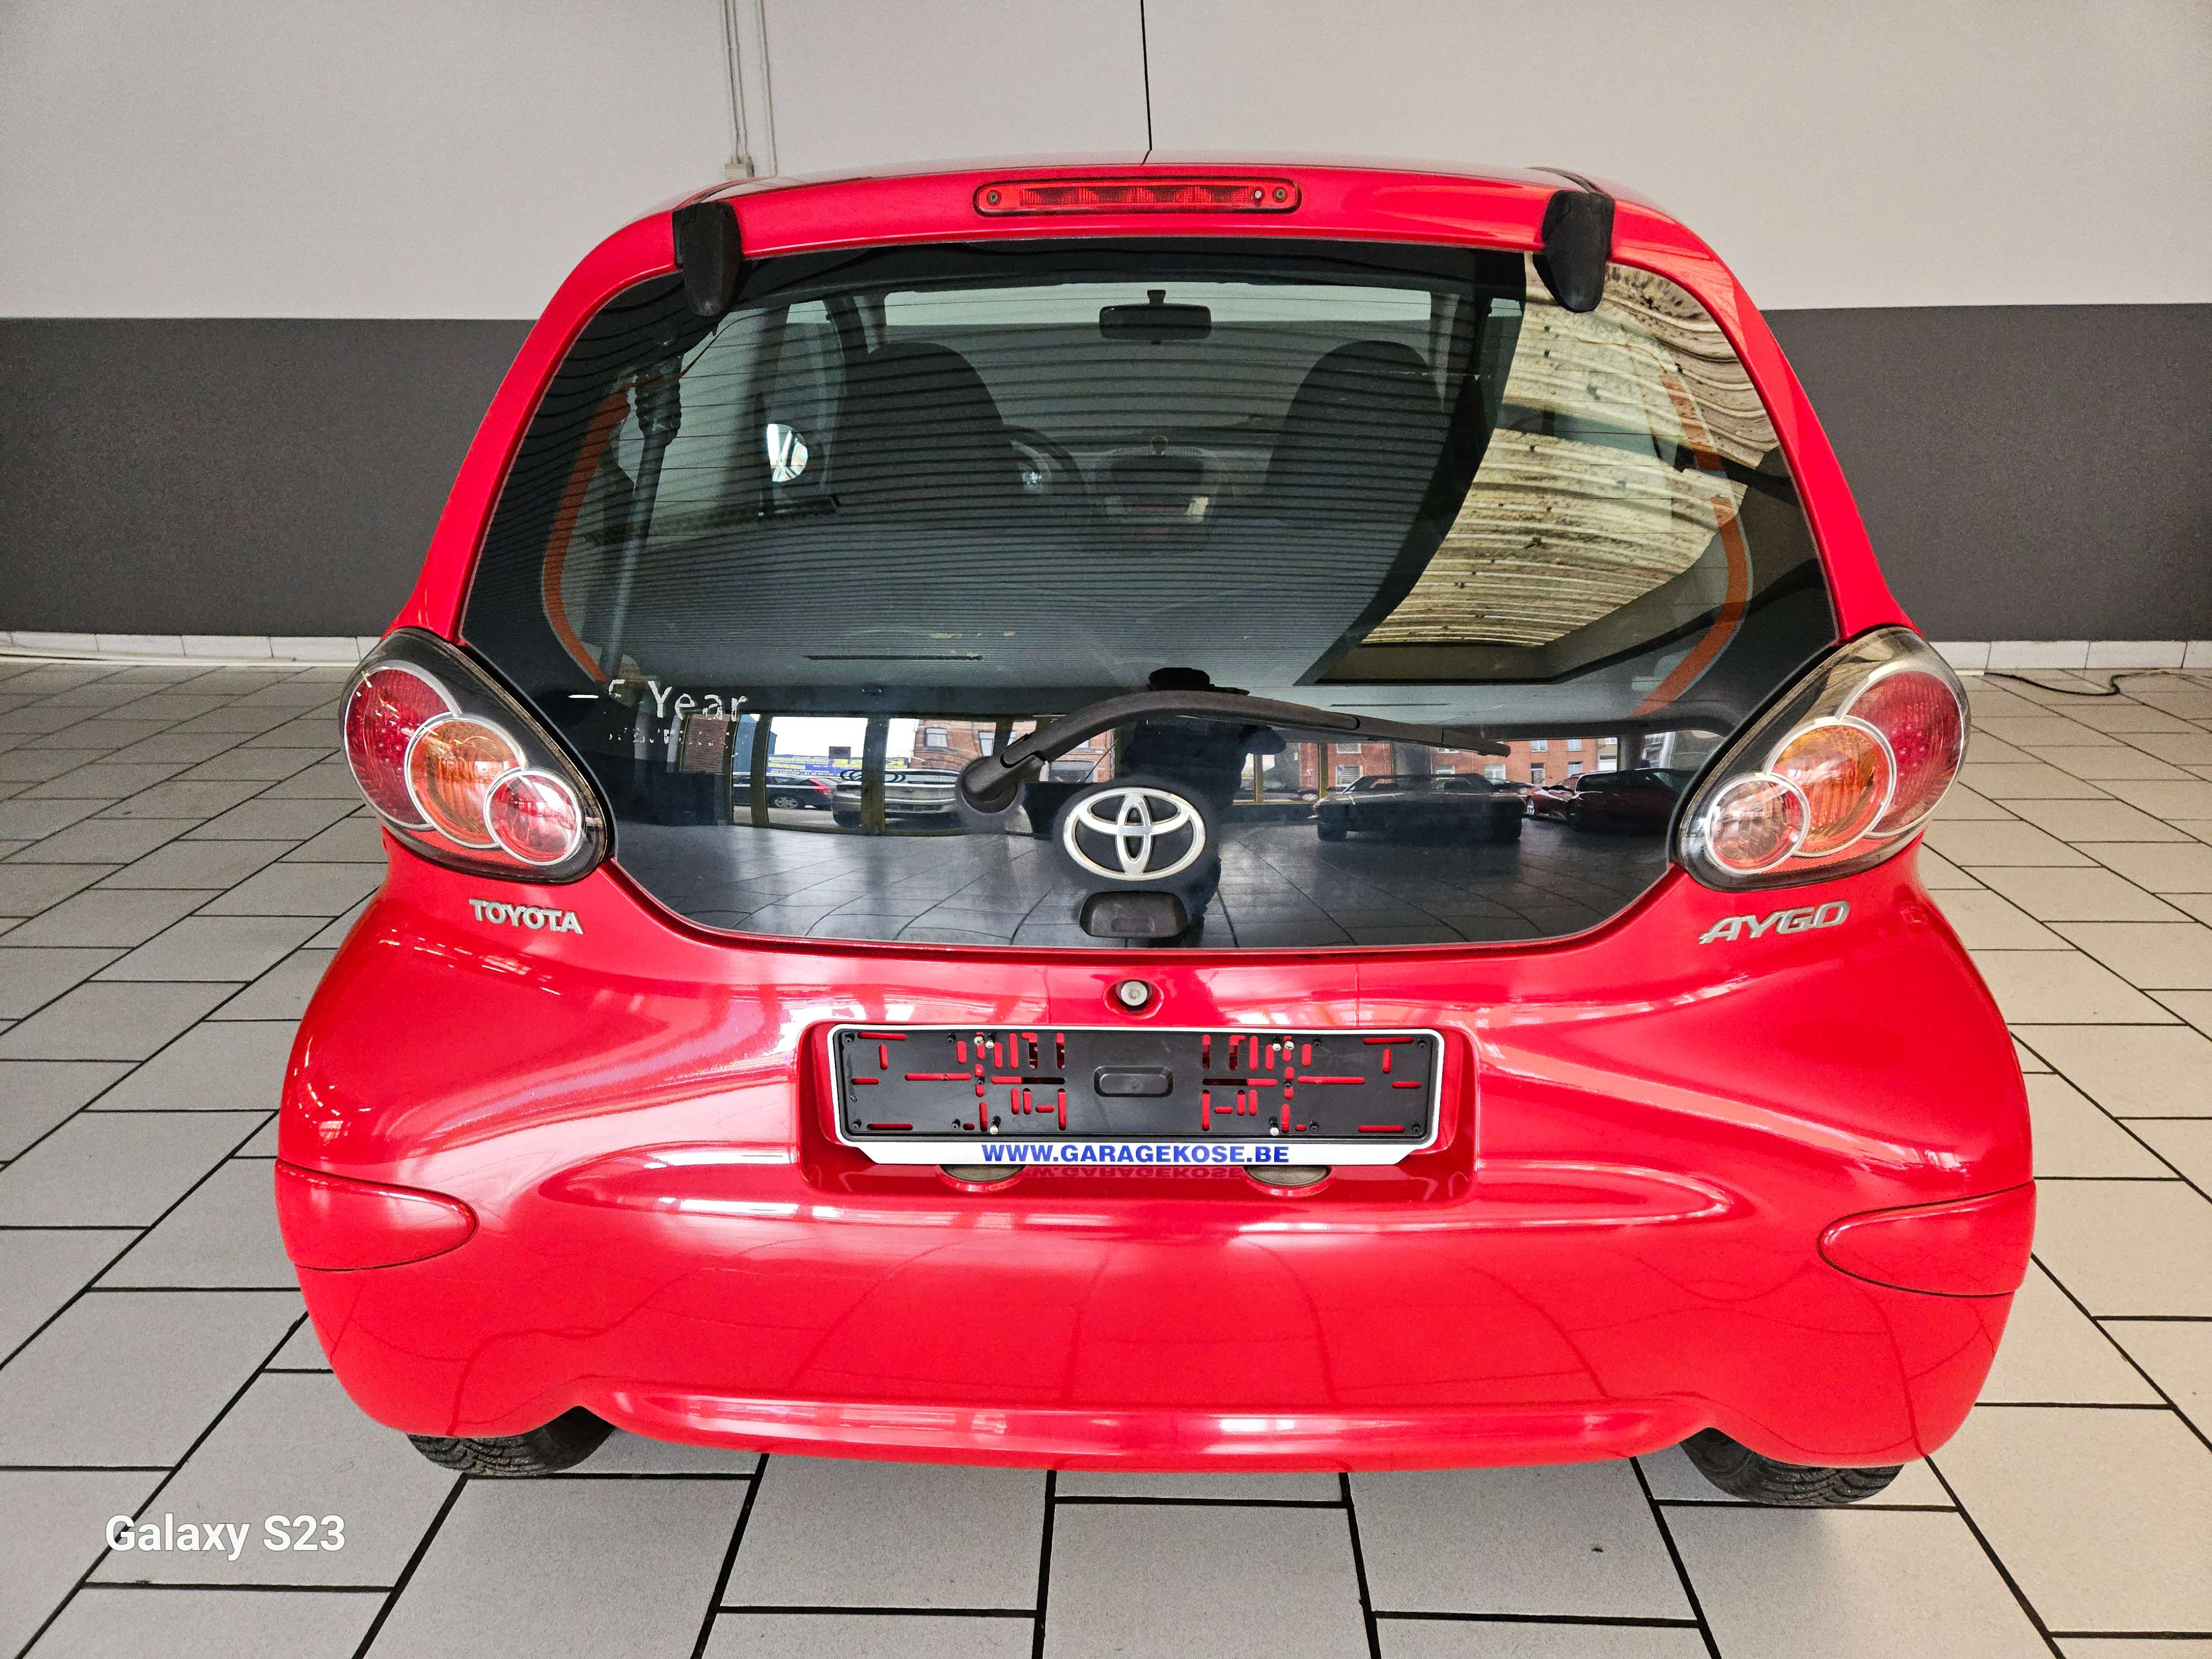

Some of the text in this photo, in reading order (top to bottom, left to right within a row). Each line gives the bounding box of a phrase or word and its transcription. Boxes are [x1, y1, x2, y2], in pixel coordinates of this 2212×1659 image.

[648, 681, 749, 722] Year
[469, 898, 584, 935] TOYOTA
[1698, 900, 1850, 945] AYGO
[981, 1144, 1290, 1162] WWW.GARAGEKOSE.BE
